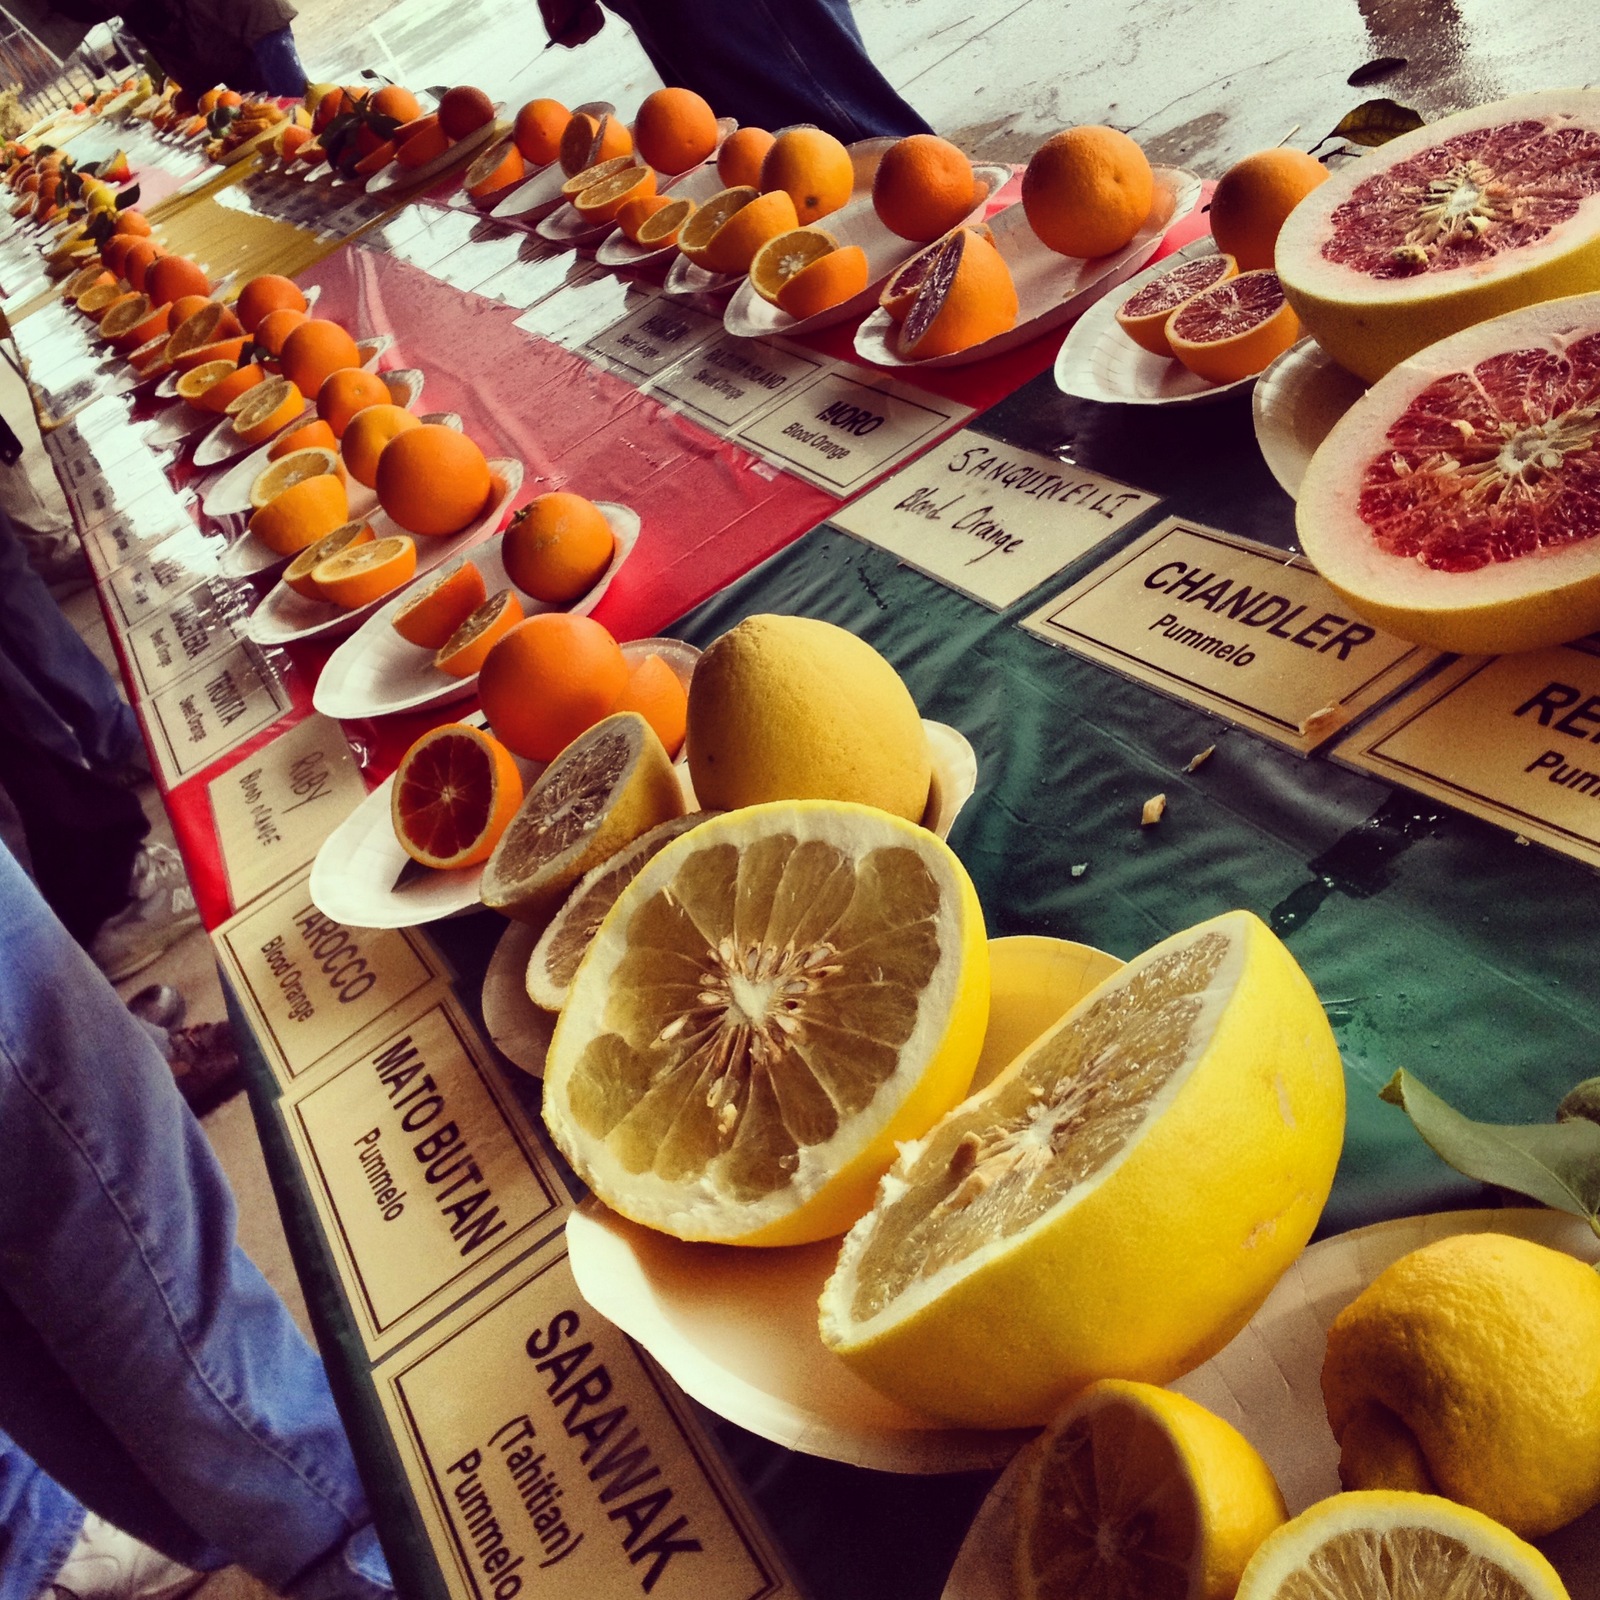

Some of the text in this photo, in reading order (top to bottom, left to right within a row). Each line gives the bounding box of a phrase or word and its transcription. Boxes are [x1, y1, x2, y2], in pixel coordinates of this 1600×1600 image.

[693, 369, 745, 400] Sweet Orange
[740, 364, 787, 390] ISLAND
[782, 422, 851, 460] Blood Orange
[815, 400, 885, 436] MORO
[951, 505, 1024, 567] Orange
[1143, 560, 1377, 662] CHANDLER
[1148, 613, 1257, 668] Pummelo
[179, 694, 207, 743] Sweet Orange
[205, 670, 248, 728] TROVITA
[1513, 682, 1600, 744] RE
[261, 935, 314, 1022] Blood Orange
[353, 1128, 405, 1222] Pummelo
[371, 1036, 508, 1257] MATO BUTAN
[525, 1310, 704, 1594] SARAWAK
[487, 1414, 584, 1568] (Tahitian)
[446, 1448, 525, 1600] Pummelo
